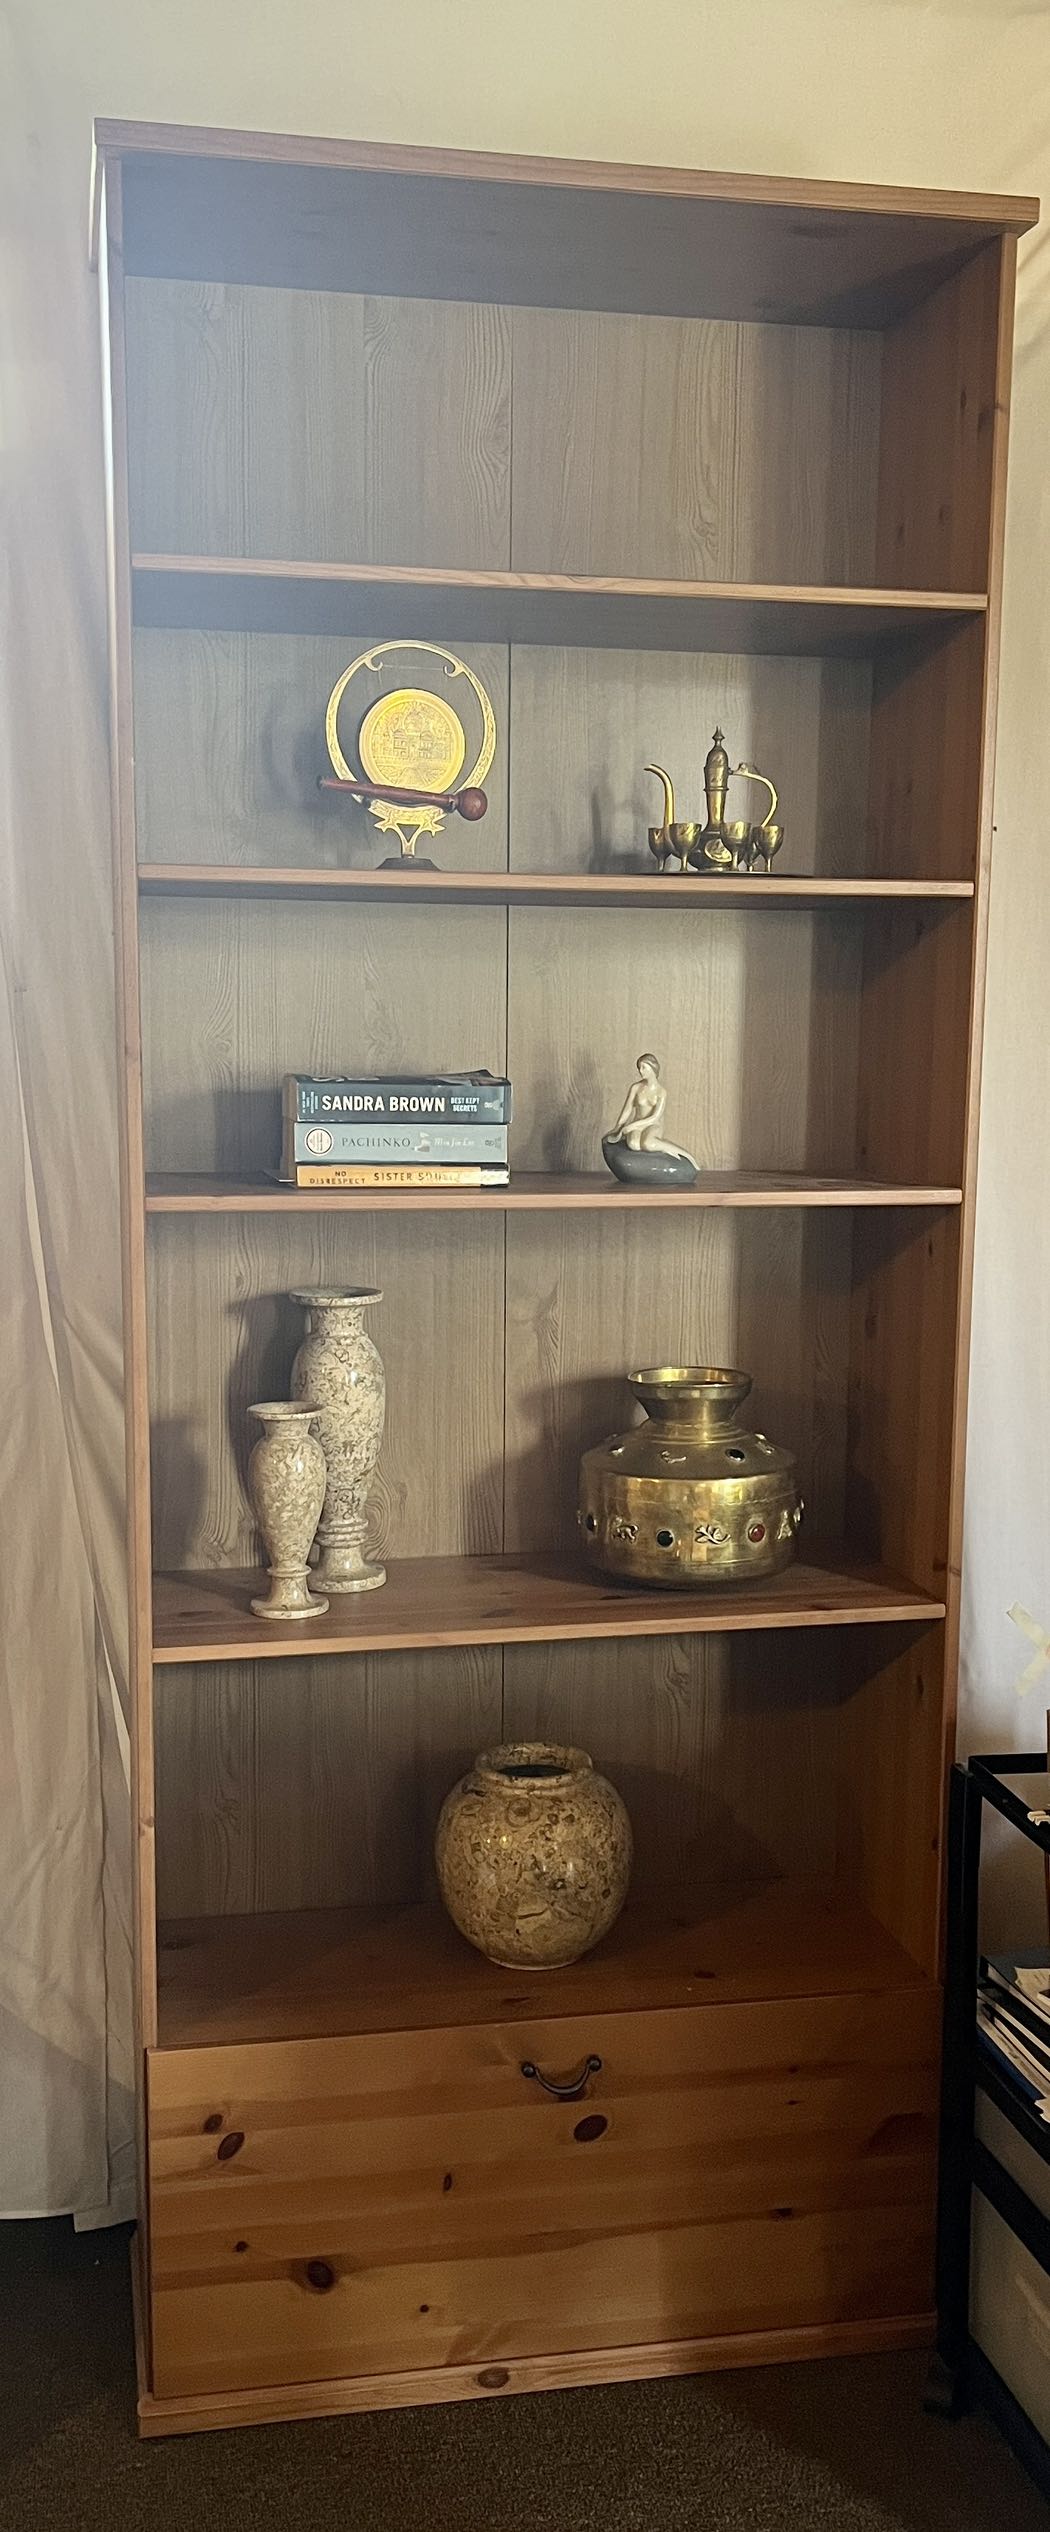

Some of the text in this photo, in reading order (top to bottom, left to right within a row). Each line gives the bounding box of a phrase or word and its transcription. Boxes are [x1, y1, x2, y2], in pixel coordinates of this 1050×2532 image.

[321, 1095, 385, 1111] SANDRA
[389, 1096, 445, 1112] BROWN
[450, 1097, 465, 1105] BEST
[465, 1097, 480, 1105] KEPT
[452, 1104, 478, 1112] SECRETS
[341, 1137, 411, 1147] PACHINKO
[373, 1172, 412, 1181] SISTER
[309, 1177, 366, 1185] DISRESPECT
